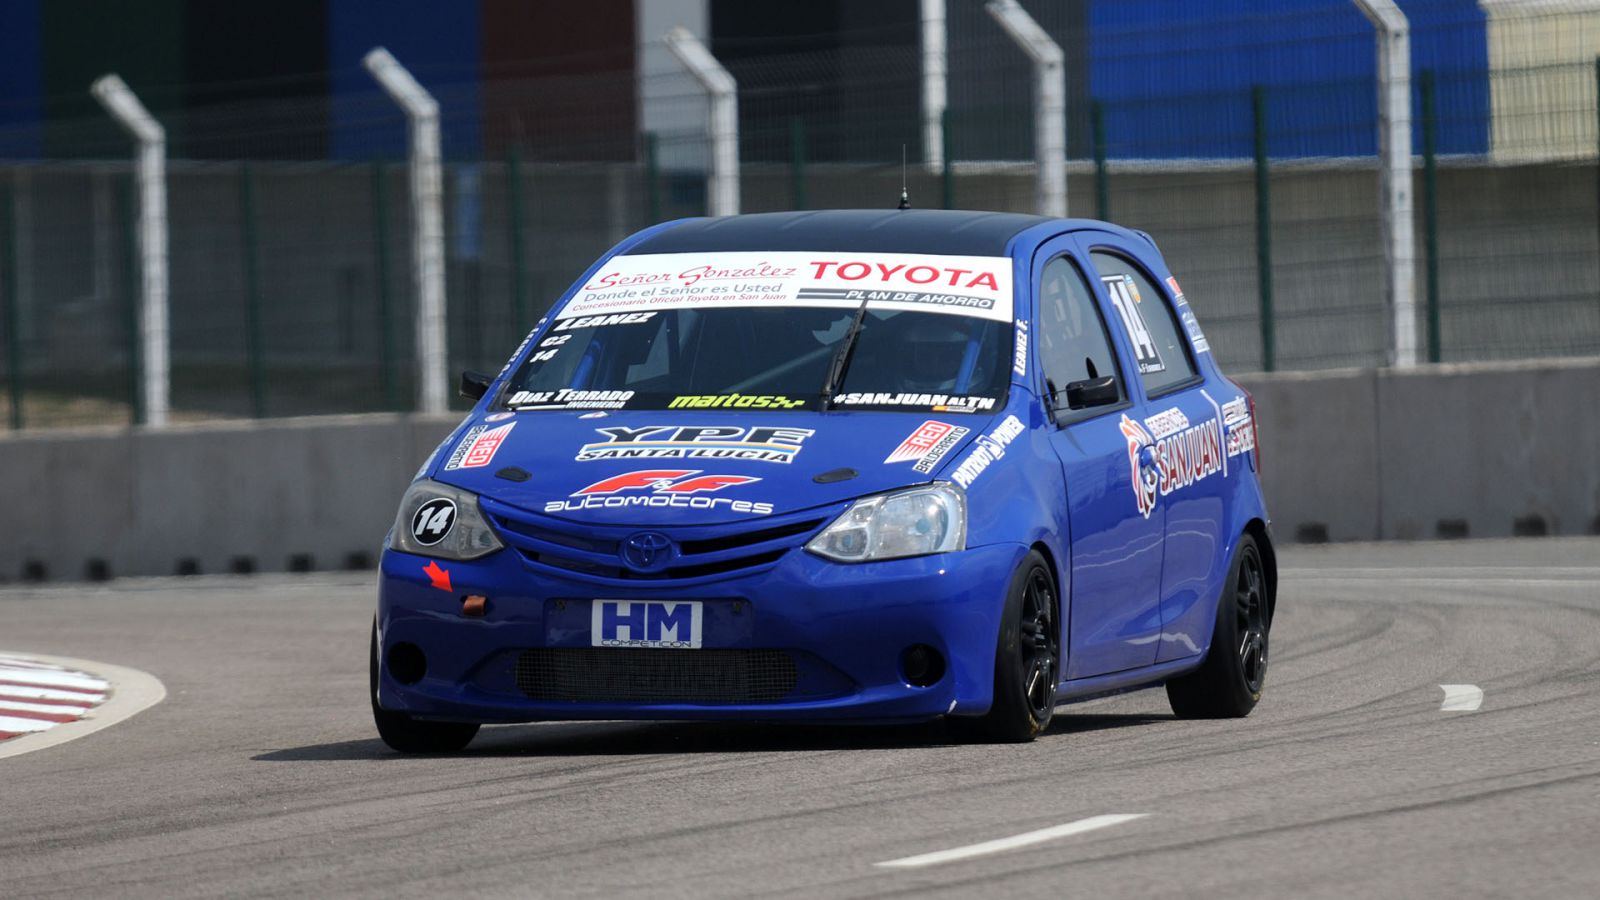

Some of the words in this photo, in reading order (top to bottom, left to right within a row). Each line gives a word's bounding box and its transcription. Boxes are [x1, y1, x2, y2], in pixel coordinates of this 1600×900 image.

[585, 272, 671, 290] Señor
[678, 261, 797, 286] González
[809, 261, 999, 291] TOYOTA
[571, 298, 647, 312] Concesionario
[649, 296, 683, 304] Oficial
[685, 295, 720, 303] Toyota
[761, 293, 788, 301] Juan
[583, 290, 638, 303] Donde
[641, 287, 657, 298] el
[658, 284, 708, 297] Señor
[711, 285, 730, 294] es
[733, 283, 783, 294] Usted
[845, 289, 893, 302] PLAN
[893, 292, 917, 303] DE
[918, 295, 992, 308] AHORRO
[553, 311, 659, 332] LEANEZ
[1108, 280, 1156, 360] 14
[540, 334, 573, 348] C2
[529, 348, 560, 363] 14
[667, 392, 770, 409] martos
[595, 426, 816, 444] YPF
[909, 423, 948, 448] RED
[575, 447, 684, 461] SANTA
[695, 447, 793, 464] LUCIA
[544, 493, 774, 514] automotores
[415, 506, 455, 536] 14
[602, 602, 692, 642] HM
